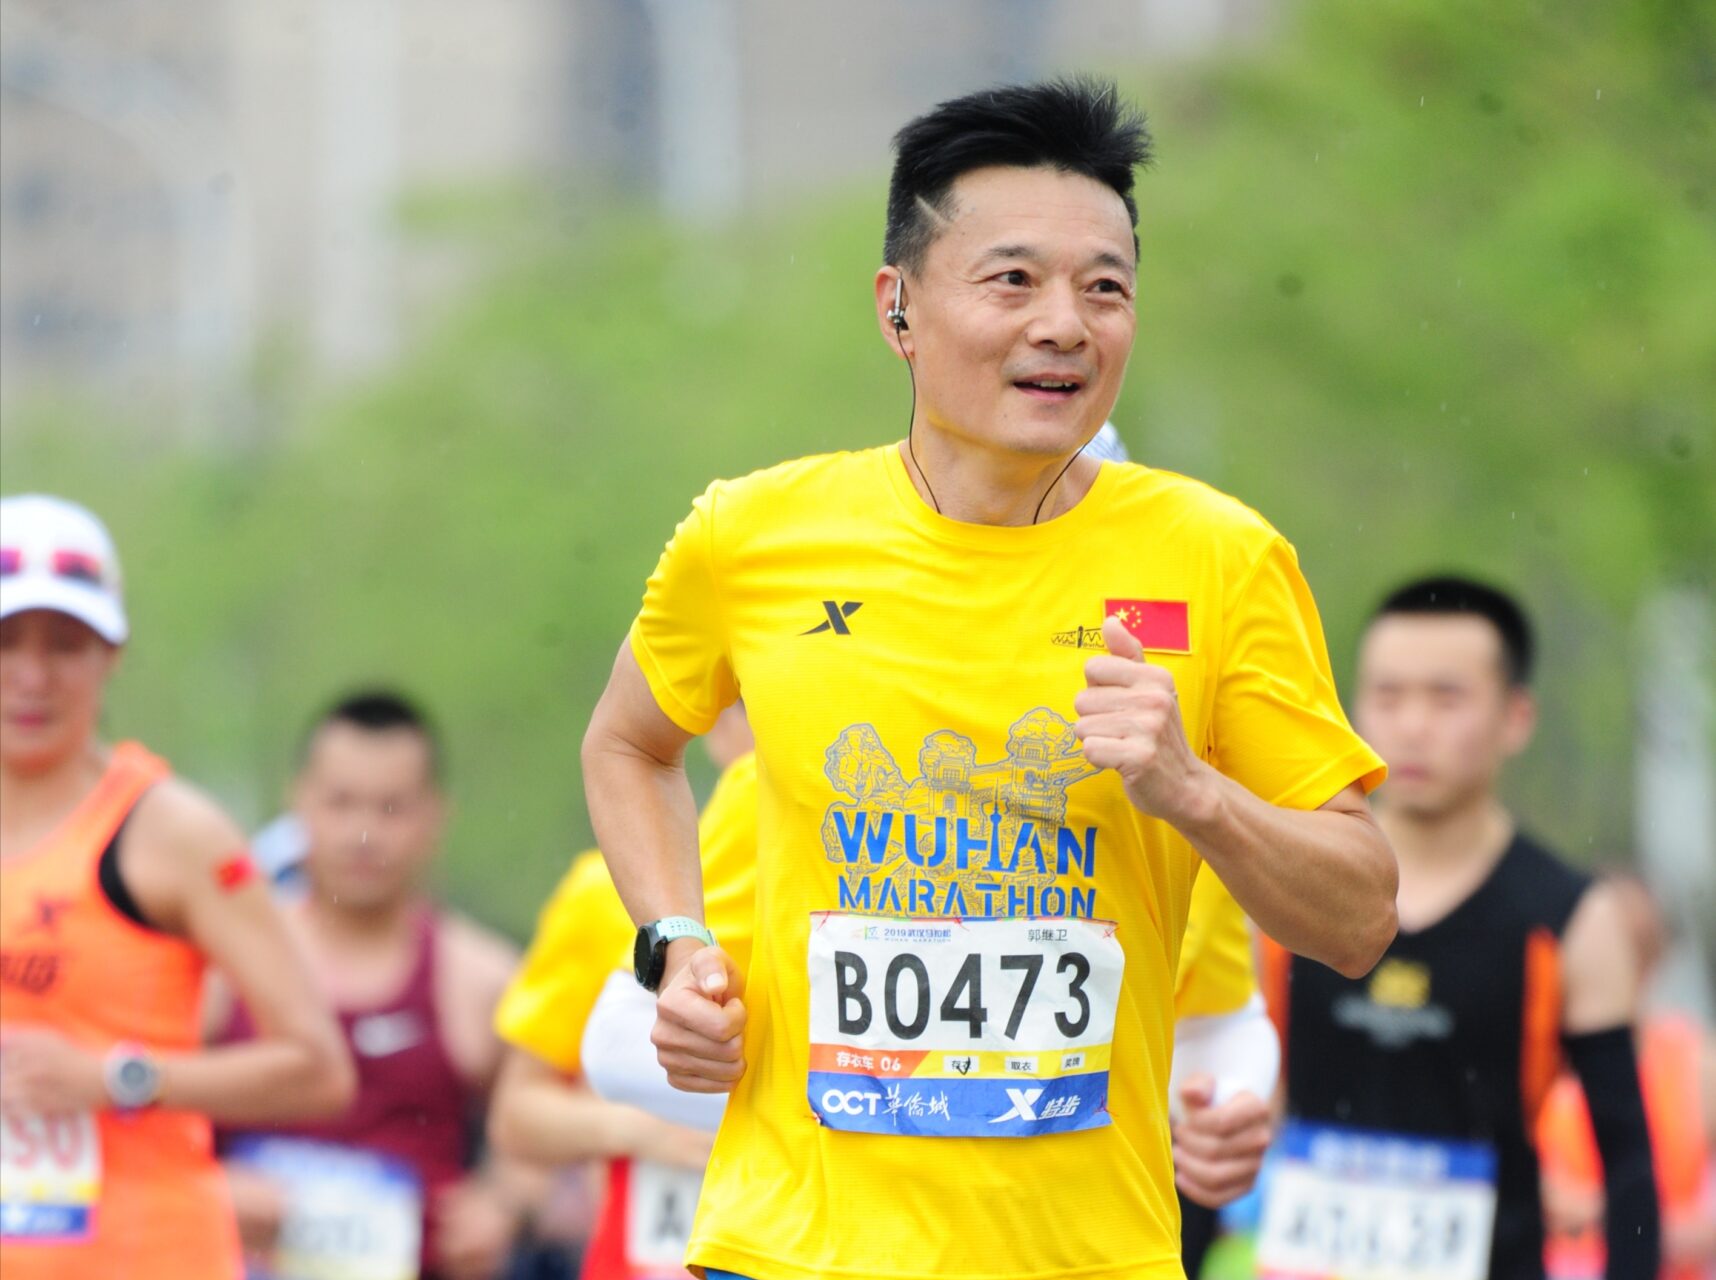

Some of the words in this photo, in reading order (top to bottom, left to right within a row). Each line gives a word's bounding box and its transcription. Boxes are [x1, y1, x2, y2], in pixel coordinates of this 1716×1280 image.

[832, 809, 1098, 878] WUHAN
[838, 875, 1097, 918] MARATHON
[834, 950, 1091, 1040] B0473
[836, 1051, 874, 1070] 存衣车
[880, 1056, 902, 1072] 06
[1010, 1061, 1032, 1071] 取衣
[821, 1088, 881, 1116] OCT
